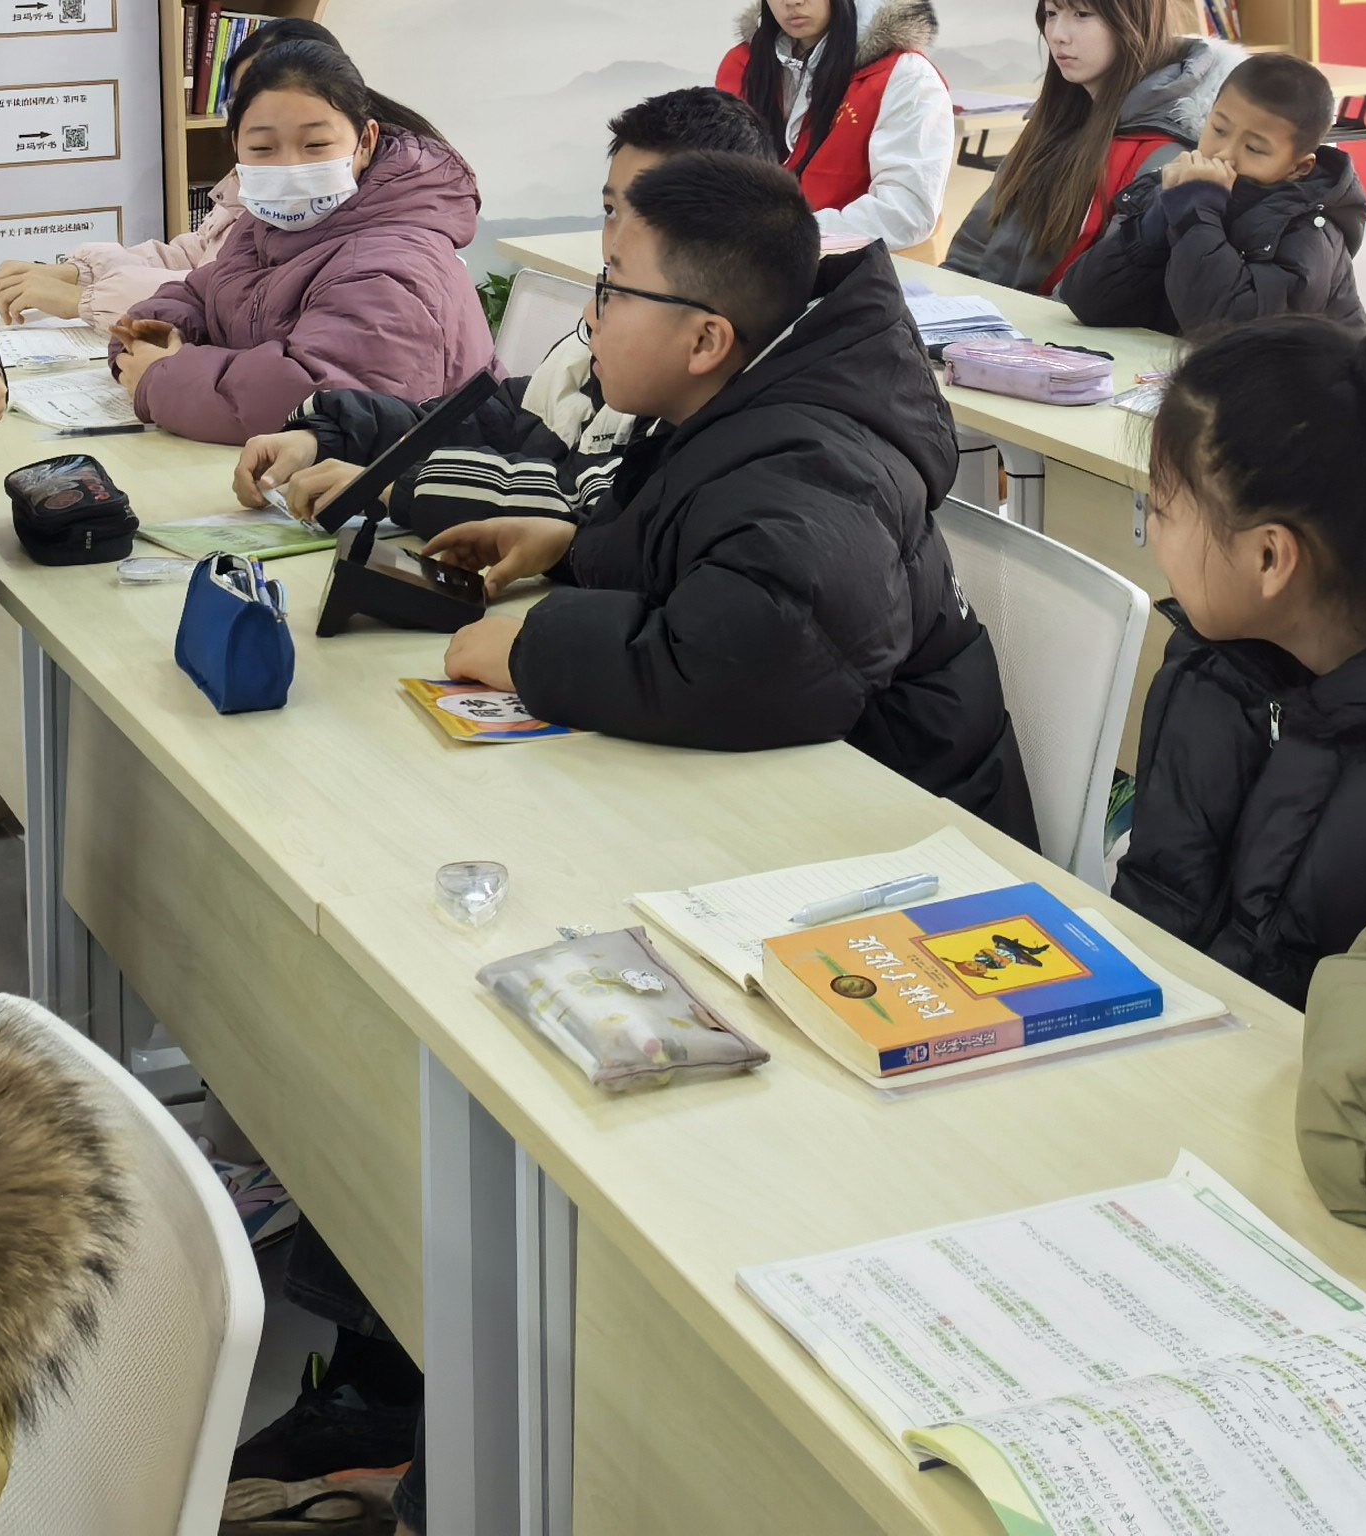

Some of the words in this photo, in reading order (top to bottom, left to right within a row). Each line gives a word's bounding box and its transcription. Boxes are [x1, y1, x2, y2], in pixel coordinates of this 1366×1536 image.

[12, 12, 54, 22] 扫码听书
[15, 141, 57, 151] 扫码听书
[260, 207, 271, 216] Be
[273, 211, 306, 222] Happy
[846, 934, 956, 1020] 长袜子皮皮
